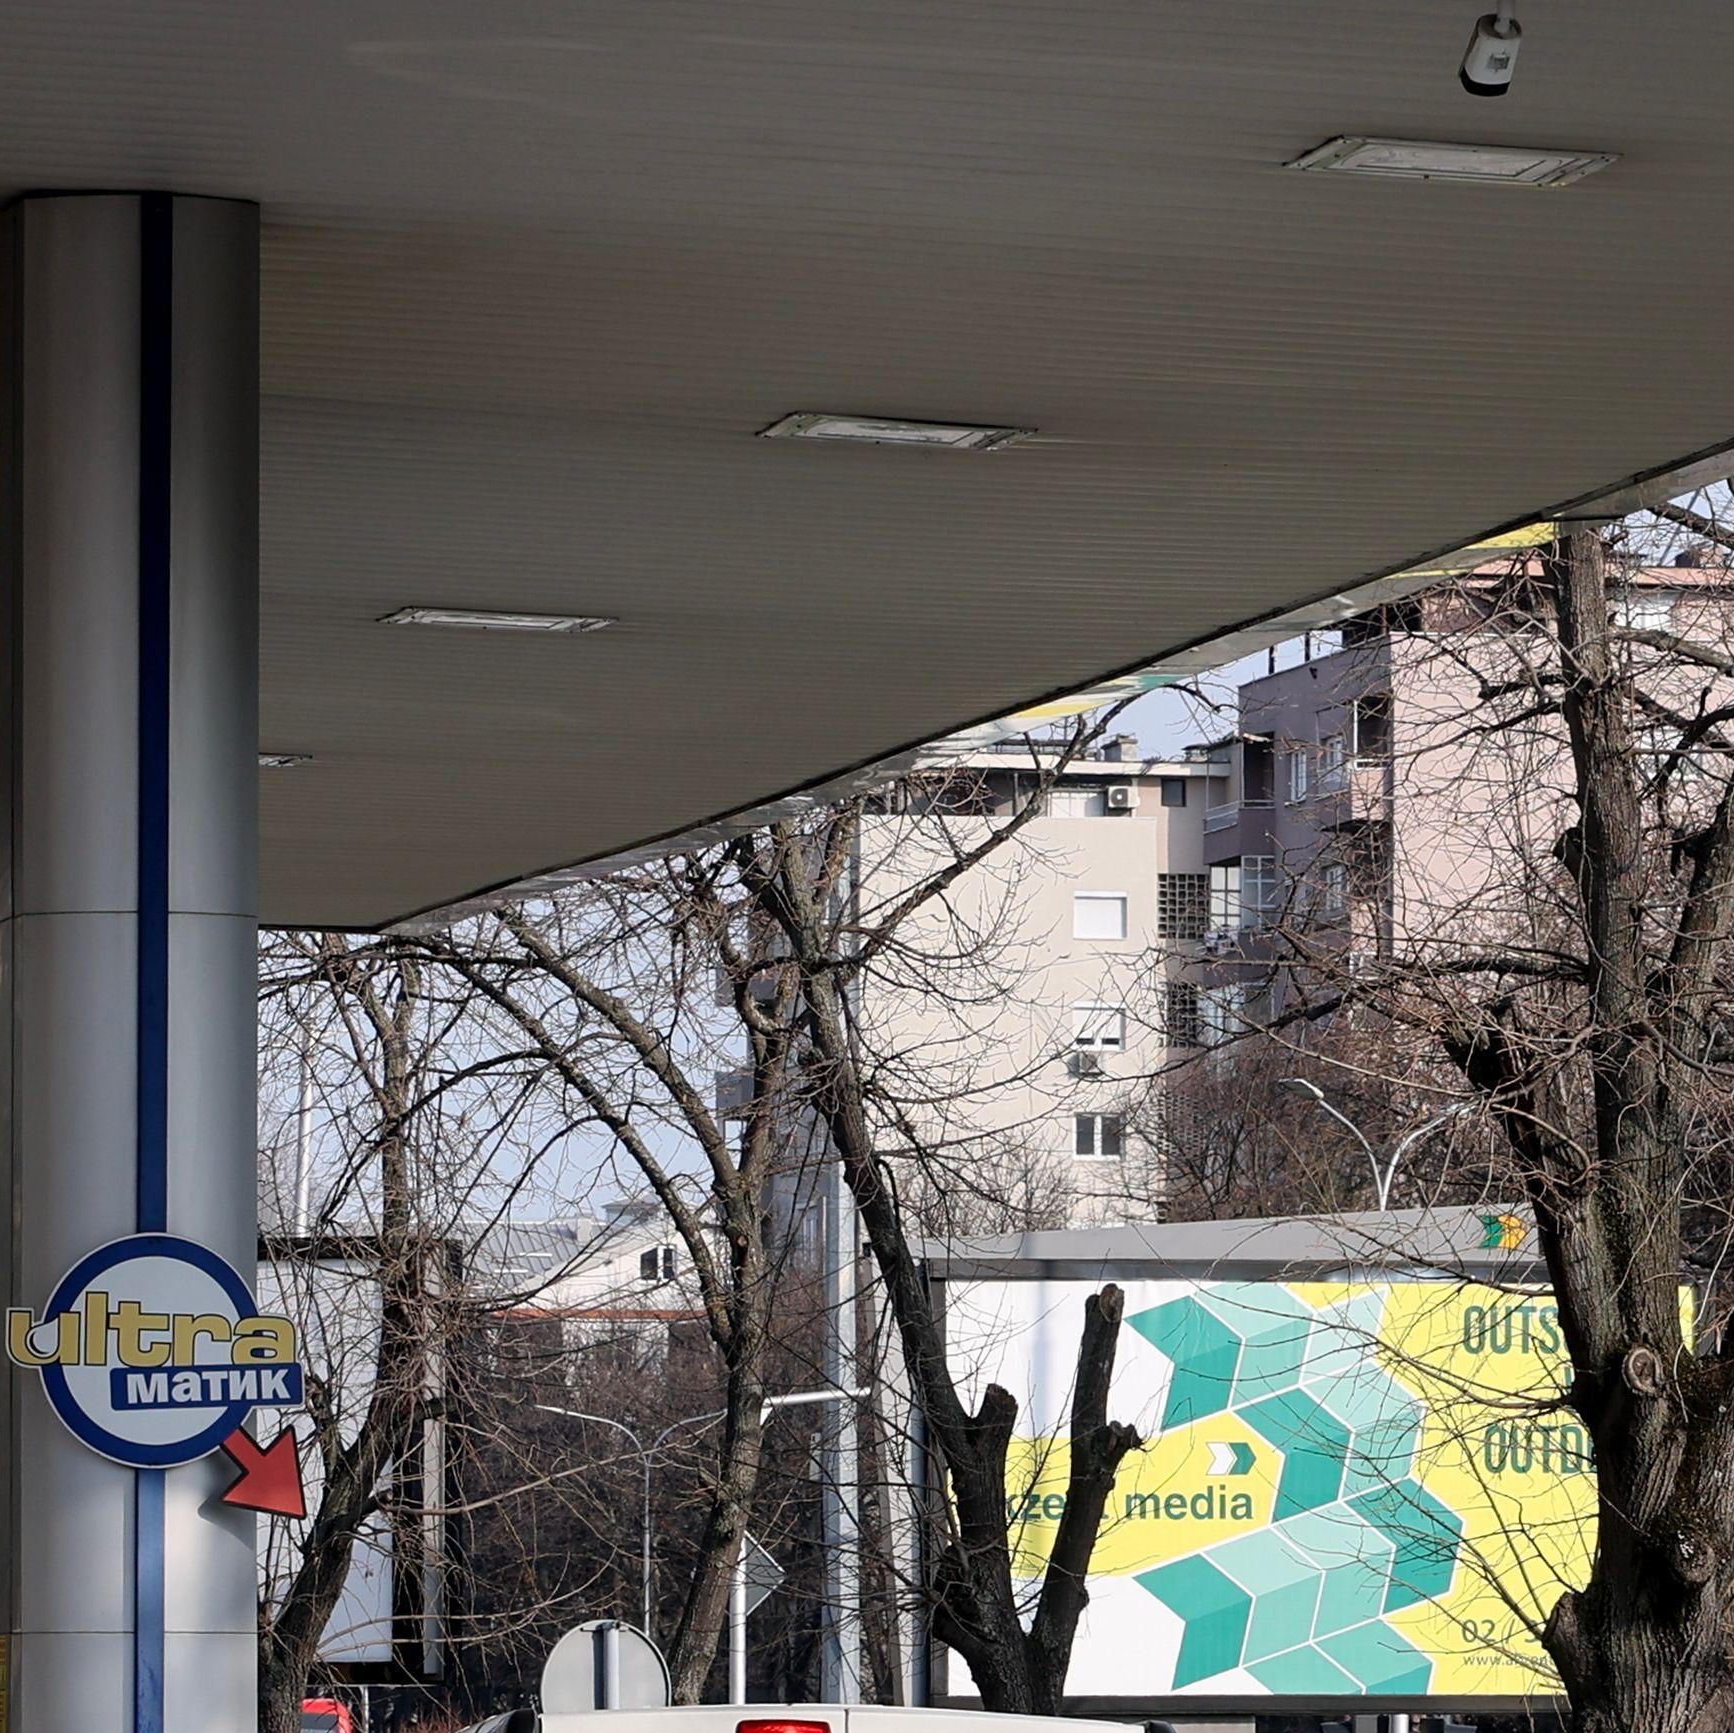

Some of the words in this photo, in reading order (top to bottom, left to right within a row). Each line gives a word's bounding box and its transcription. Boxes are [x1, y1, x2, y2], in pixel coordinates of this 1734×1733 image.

[7, 1291, 297, 1368] ultra
[1463, 1304, 1562, 1355] OUTS
[126, 1367, 291, 1404] матик
[1484, 1424, 1597, 1474] OUTD
[1126, 1484, 1254, 1520] media
